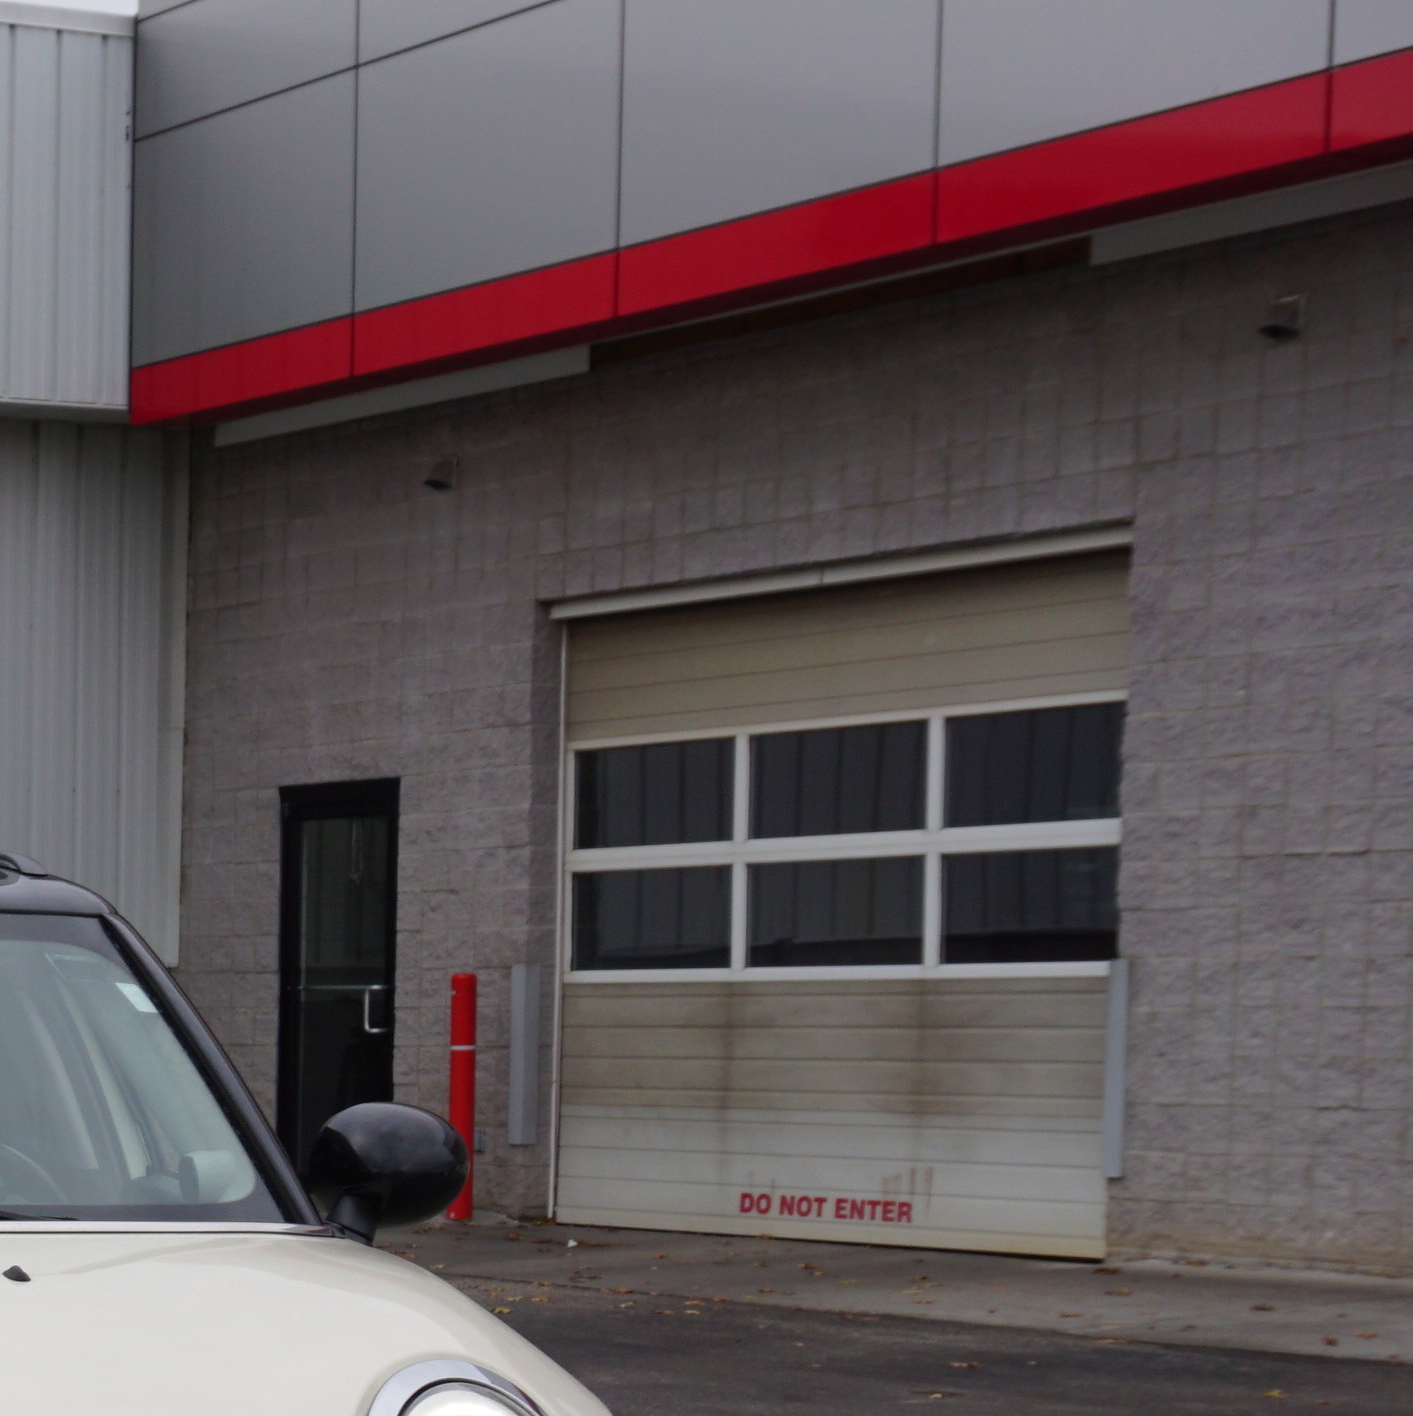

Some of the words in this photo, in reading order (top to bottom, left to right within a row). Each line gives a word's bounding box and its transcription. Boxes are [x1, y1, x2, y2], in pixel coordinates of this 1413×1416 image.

[739, 1192, 772, 1214] DO
[779, 1195, 828, 1217] NOT
[834, 1198, 914, 1223] ENTER
